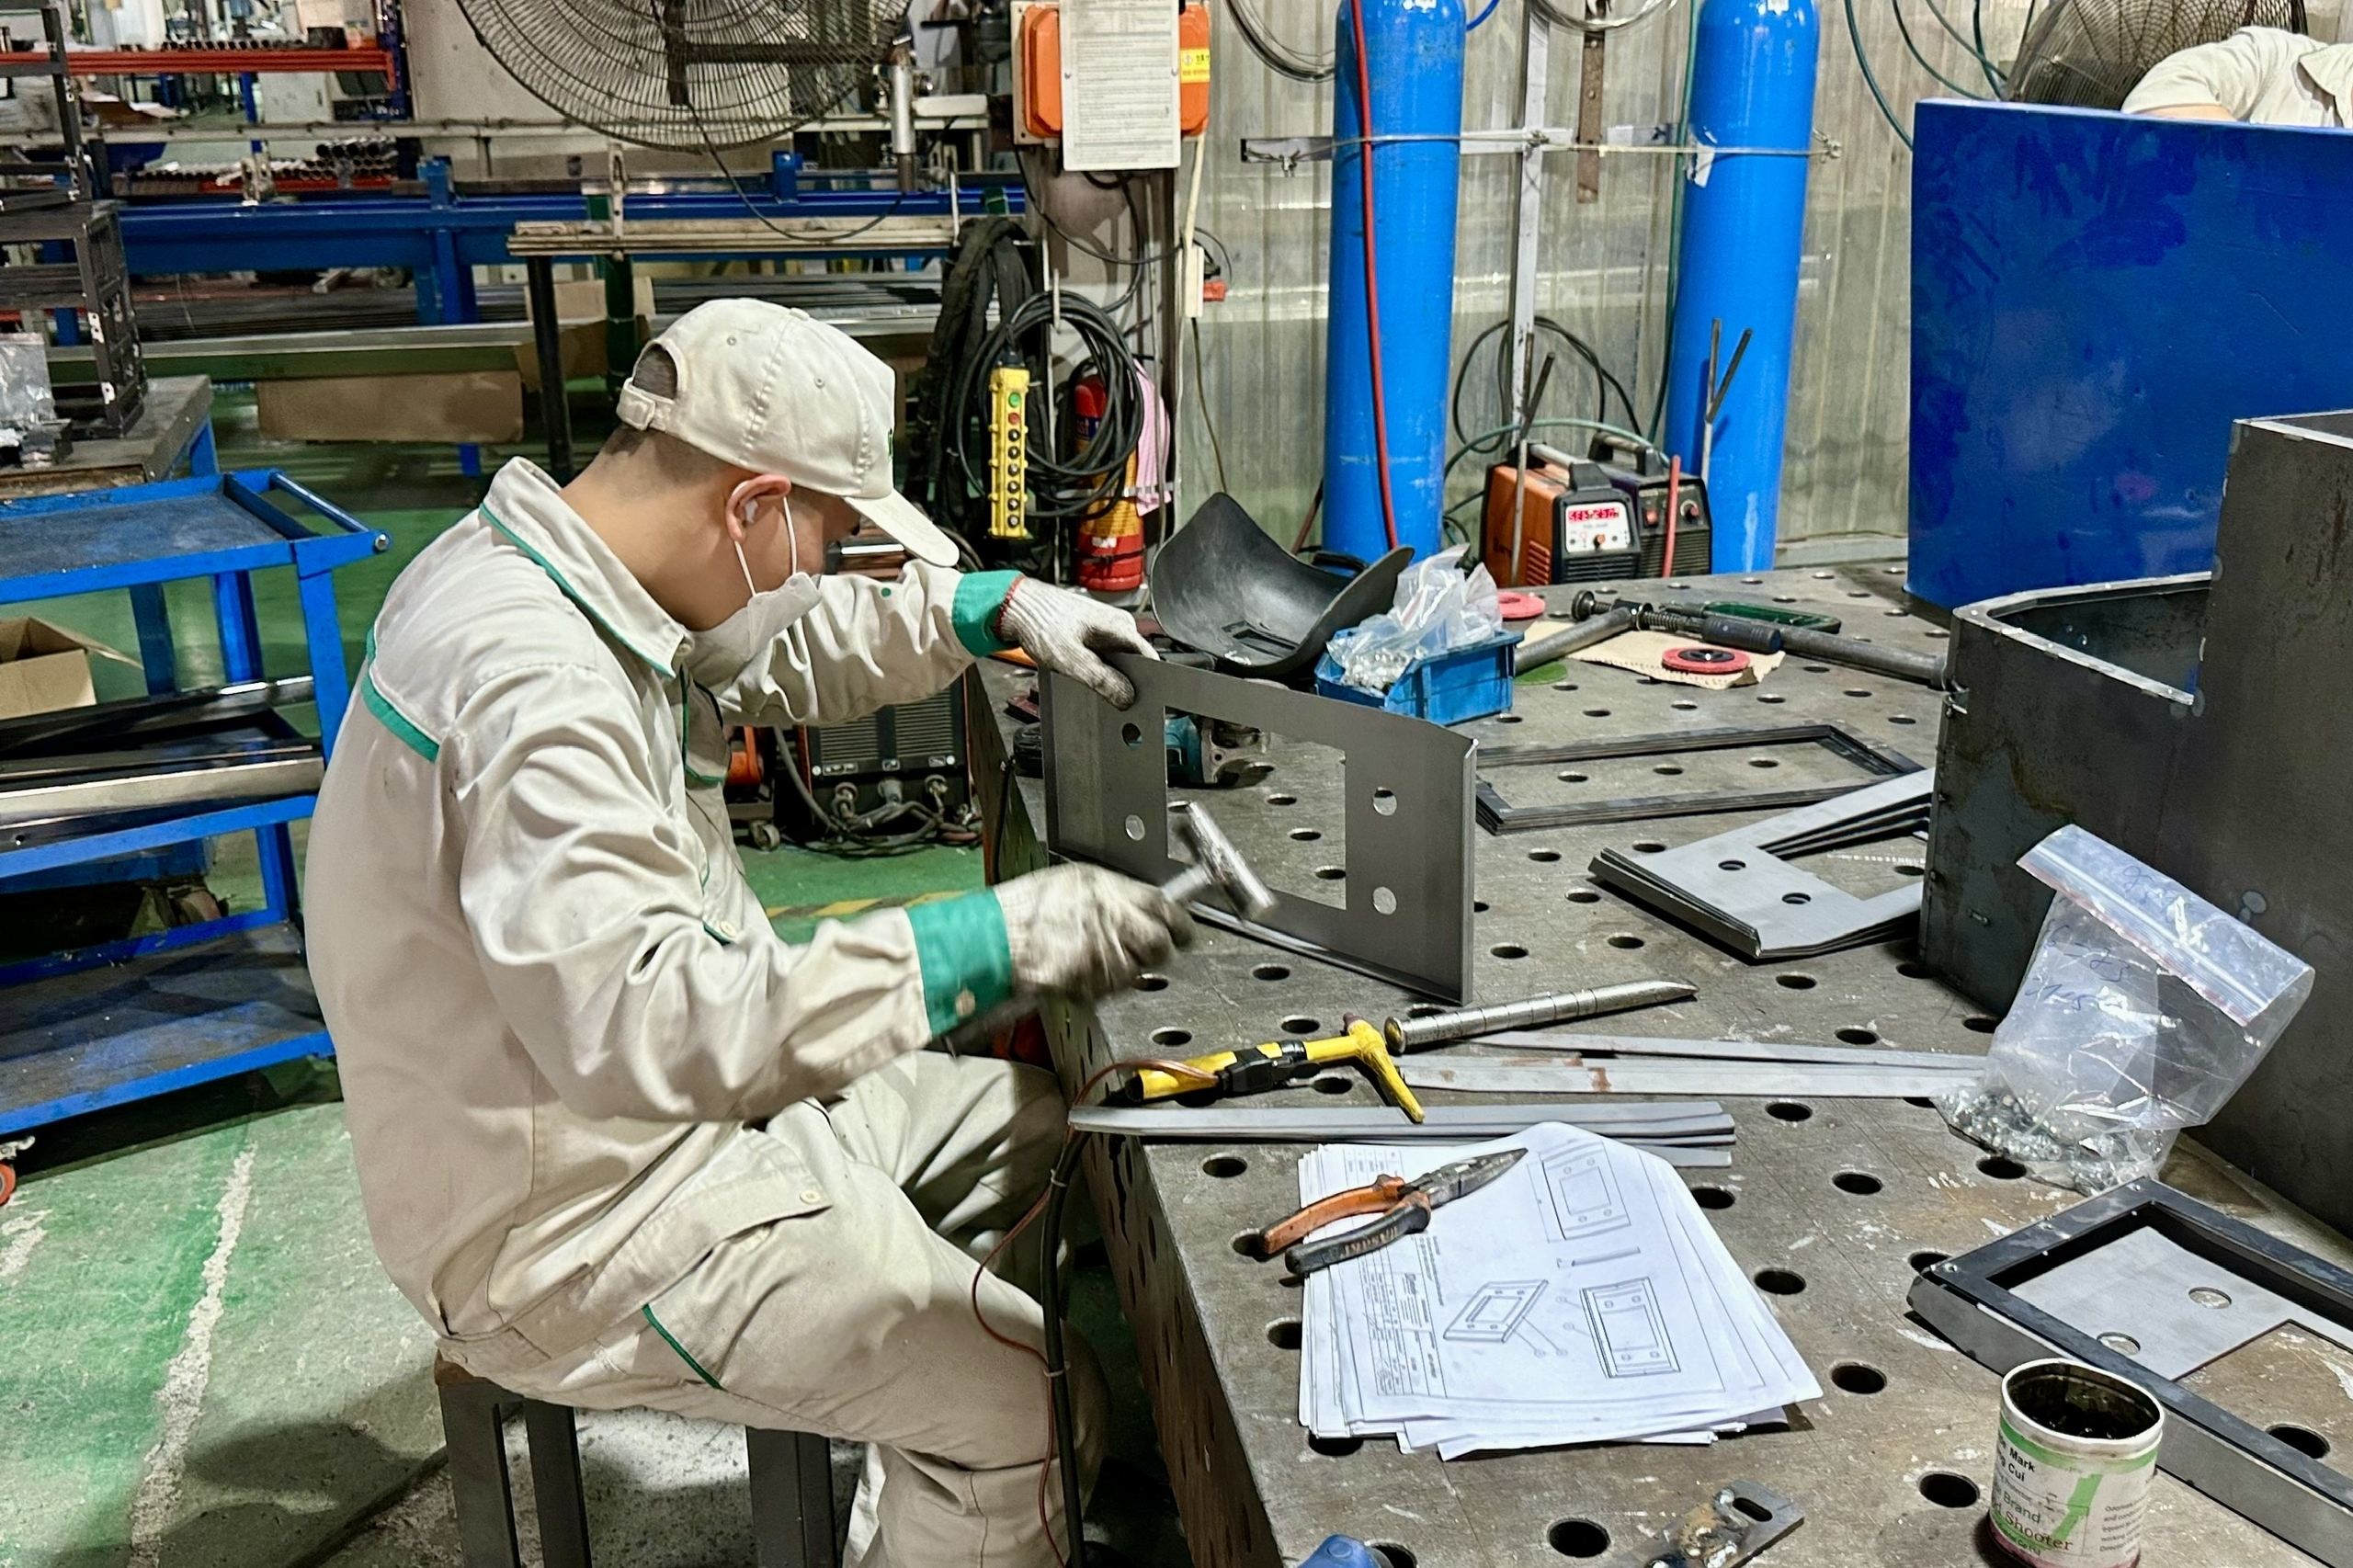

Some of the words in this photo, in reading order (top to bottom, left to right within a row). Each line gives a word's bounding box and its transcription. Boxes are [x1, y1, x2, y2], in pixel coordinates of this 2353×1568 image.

[2008, 1462, 2025, 1482] Cui
[2009, 1447, 2035, 1472] Mark
[2003, 1491, 2041, 1525] Brand
[2005, 1510, 2074, 1551] Shooter
